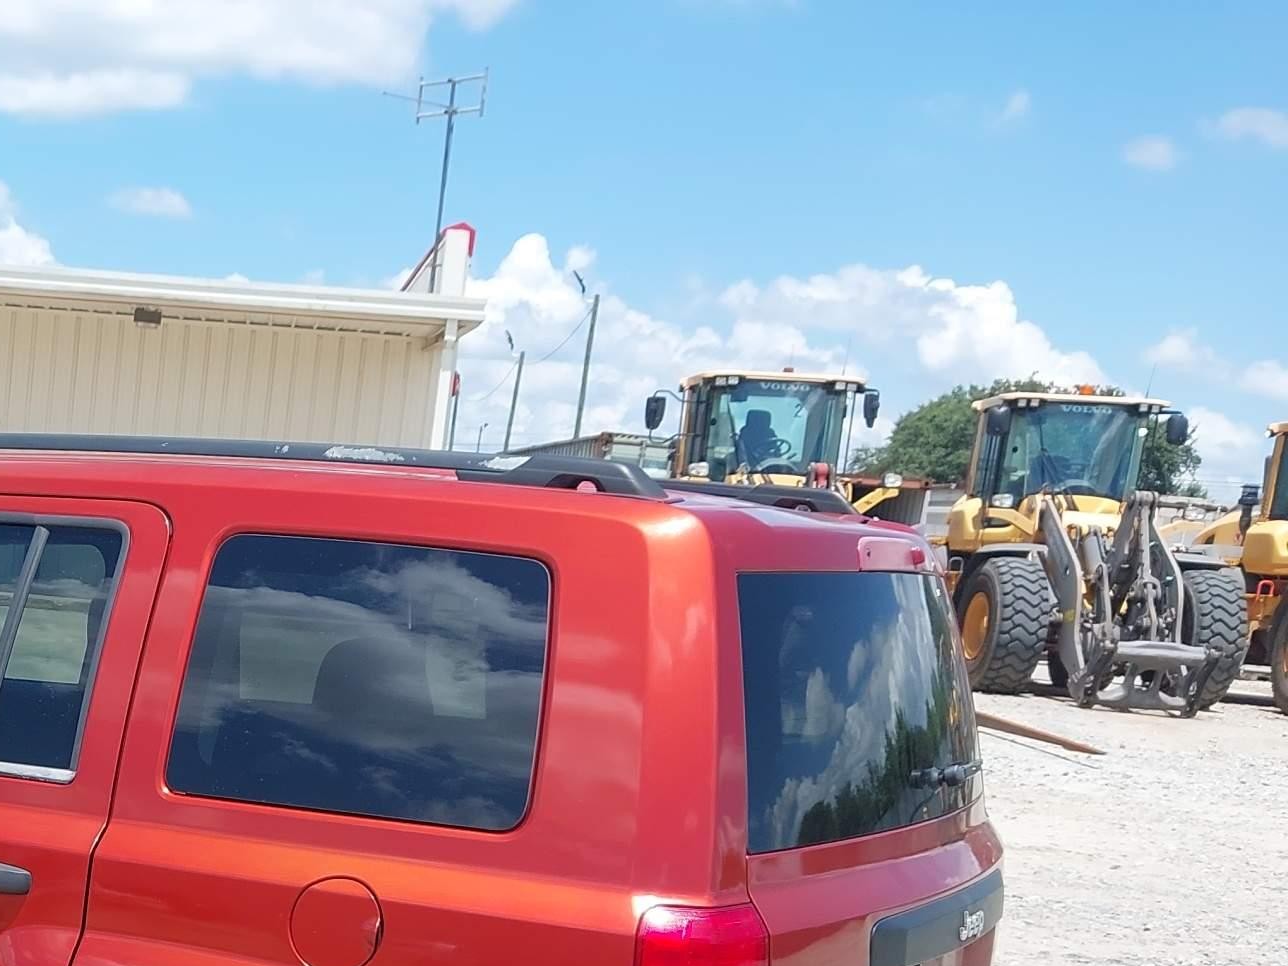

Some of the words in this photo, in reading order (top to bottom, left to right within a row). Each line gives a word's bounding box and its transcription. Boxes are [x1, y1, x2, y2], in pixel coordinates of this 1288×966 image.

[760, 381, 810, 391] VOLVO
[1061, 404, 1112, 415] VOLVO
[959, 910, 985, 941] Jeep
